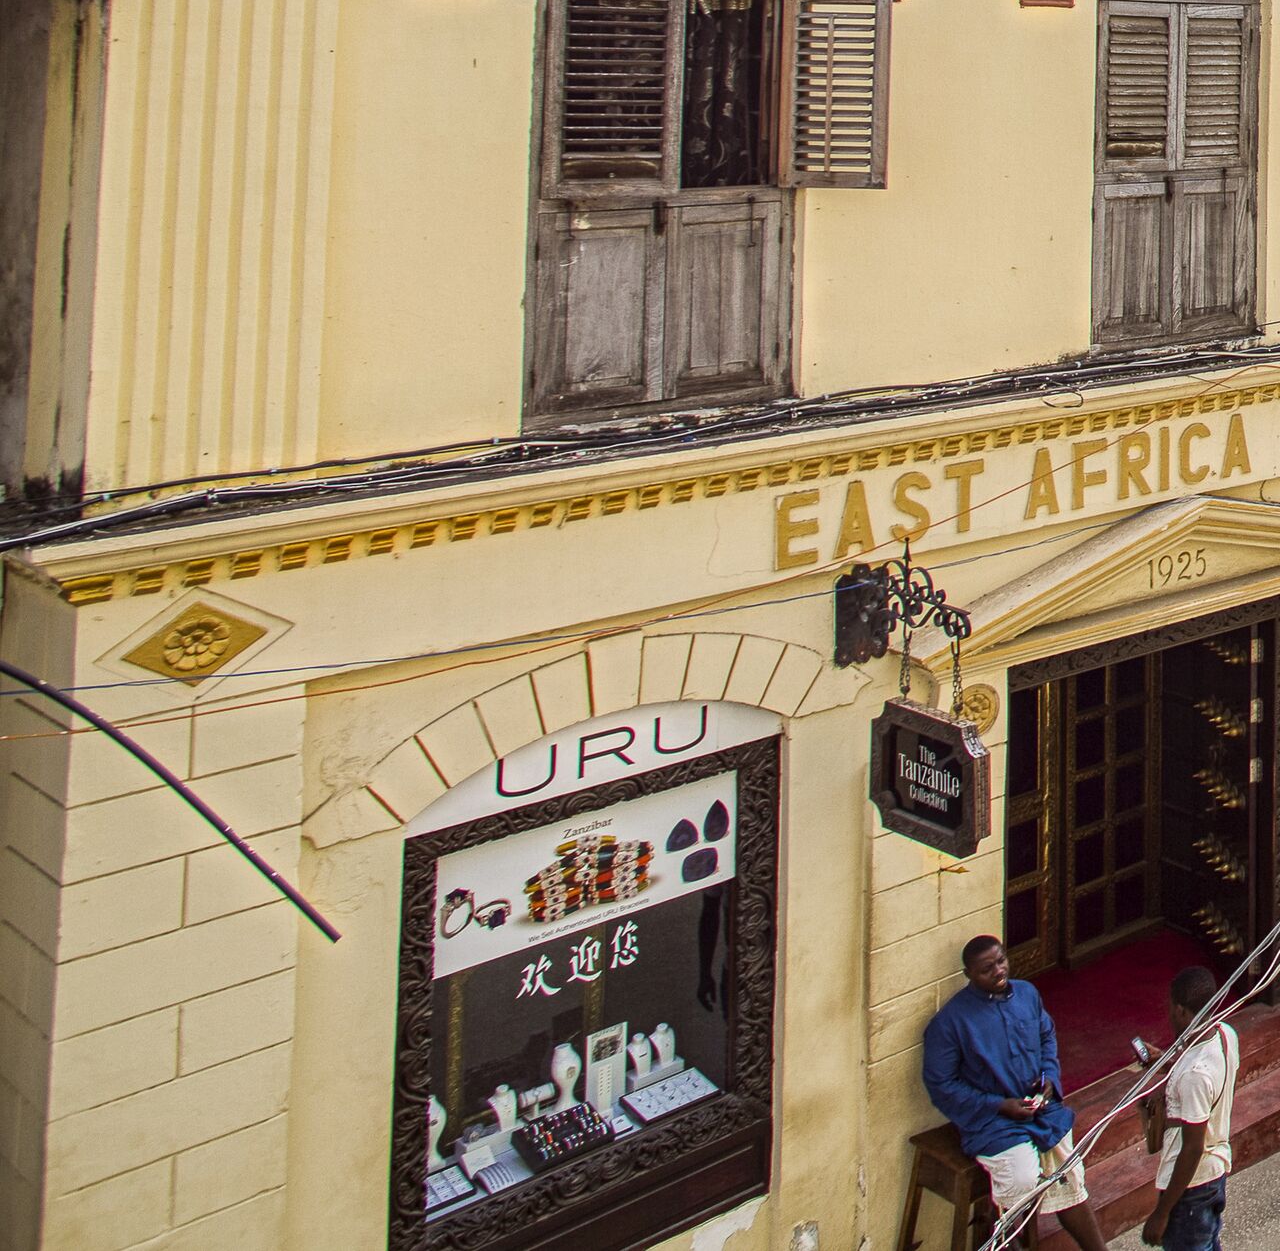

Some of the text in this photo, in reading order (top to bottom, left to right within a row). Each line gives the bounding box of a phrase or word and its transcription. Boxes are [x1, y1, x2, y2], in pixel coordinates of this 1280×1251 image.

[774, 459, 984, 572] EAST
[1024, 413, 1251, 520] AFRICA
[1147, 548, 1206, 589] 1925
[496, 704, 708, 797] URU
[919, 744, 936, 767] The
[898, 752, 960, 798] Tanzanite
[909, 784, 948, 812] Collection
[563, 818, 613, 839] Zanzibar
[541, 928, 554, 939] Sell
[555, 913, 602, 934] Authenticated
[602, 908, 618, 918] URU
[515, 920, 640, 1000] 欢迎您
